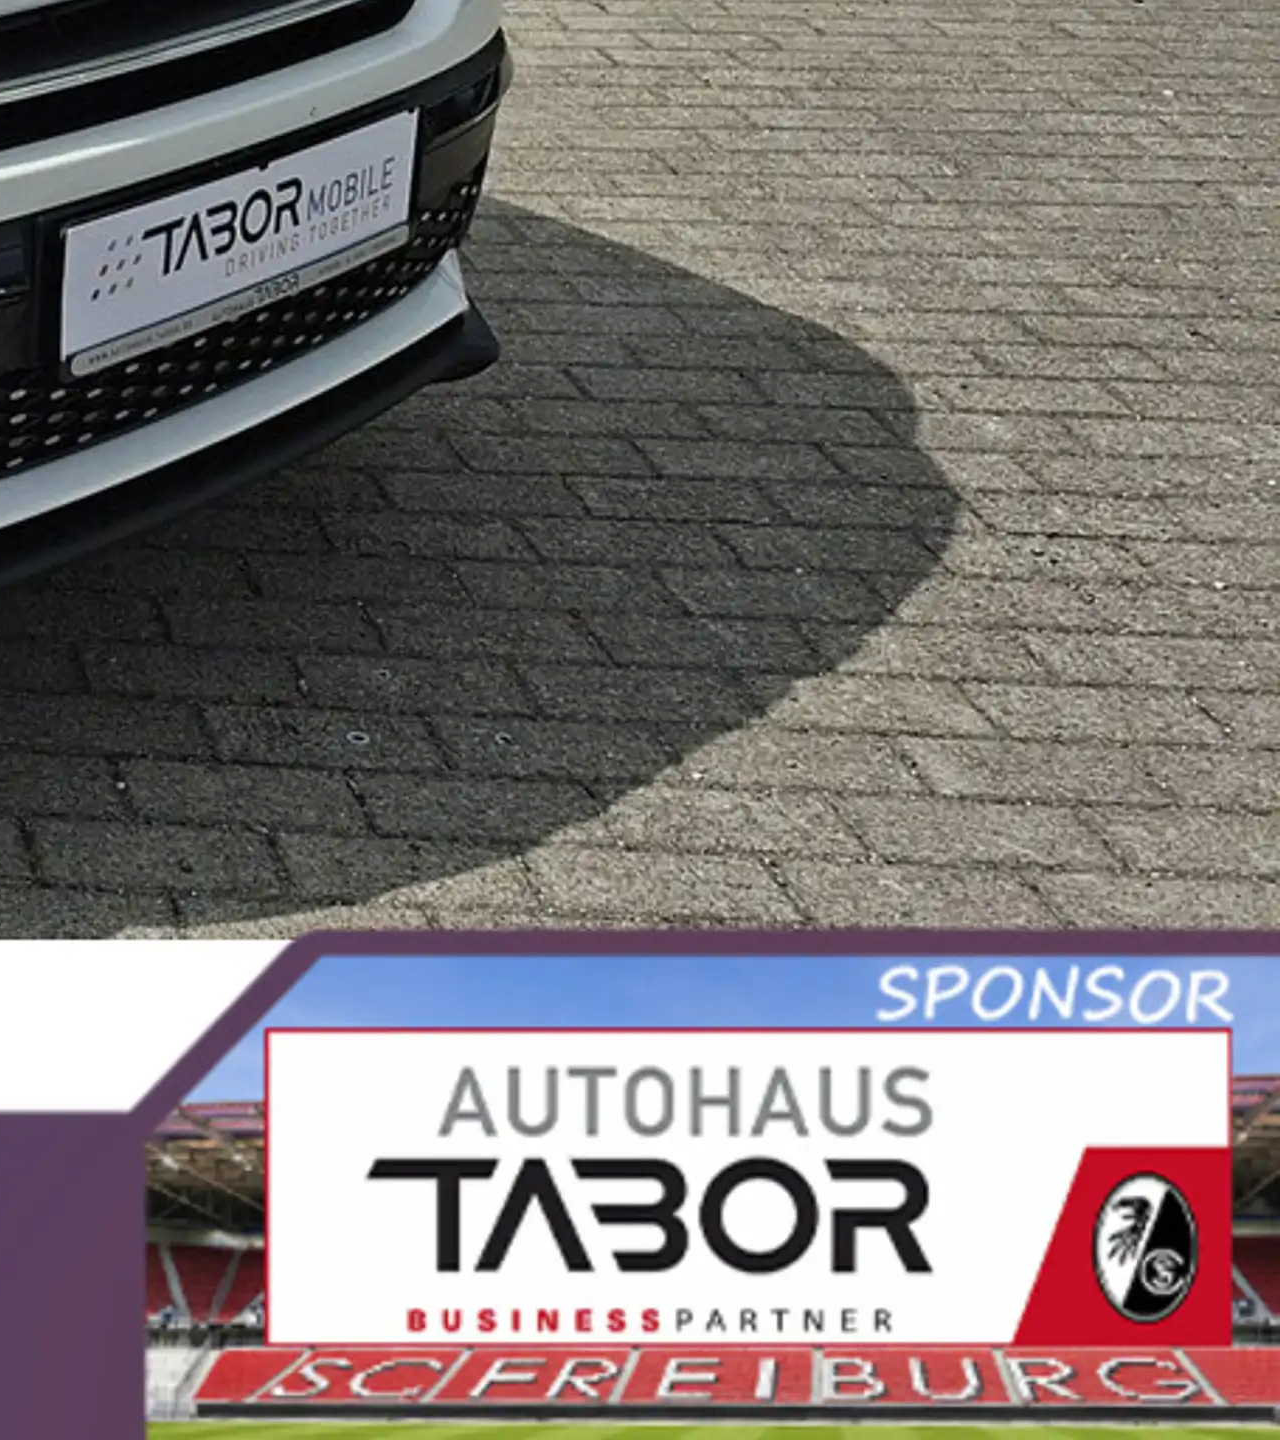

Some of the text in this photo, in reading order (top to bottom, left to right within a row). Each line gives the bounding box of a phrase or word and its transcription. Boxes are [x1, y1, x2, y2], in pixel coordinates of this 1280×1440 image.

[142, 176, 303, 276] TABOR
[306, 157, 396, 221] MOBILE
[224, 235, 302, 278] DRIVING
[309, 194, 392, 243] TOGETHER
